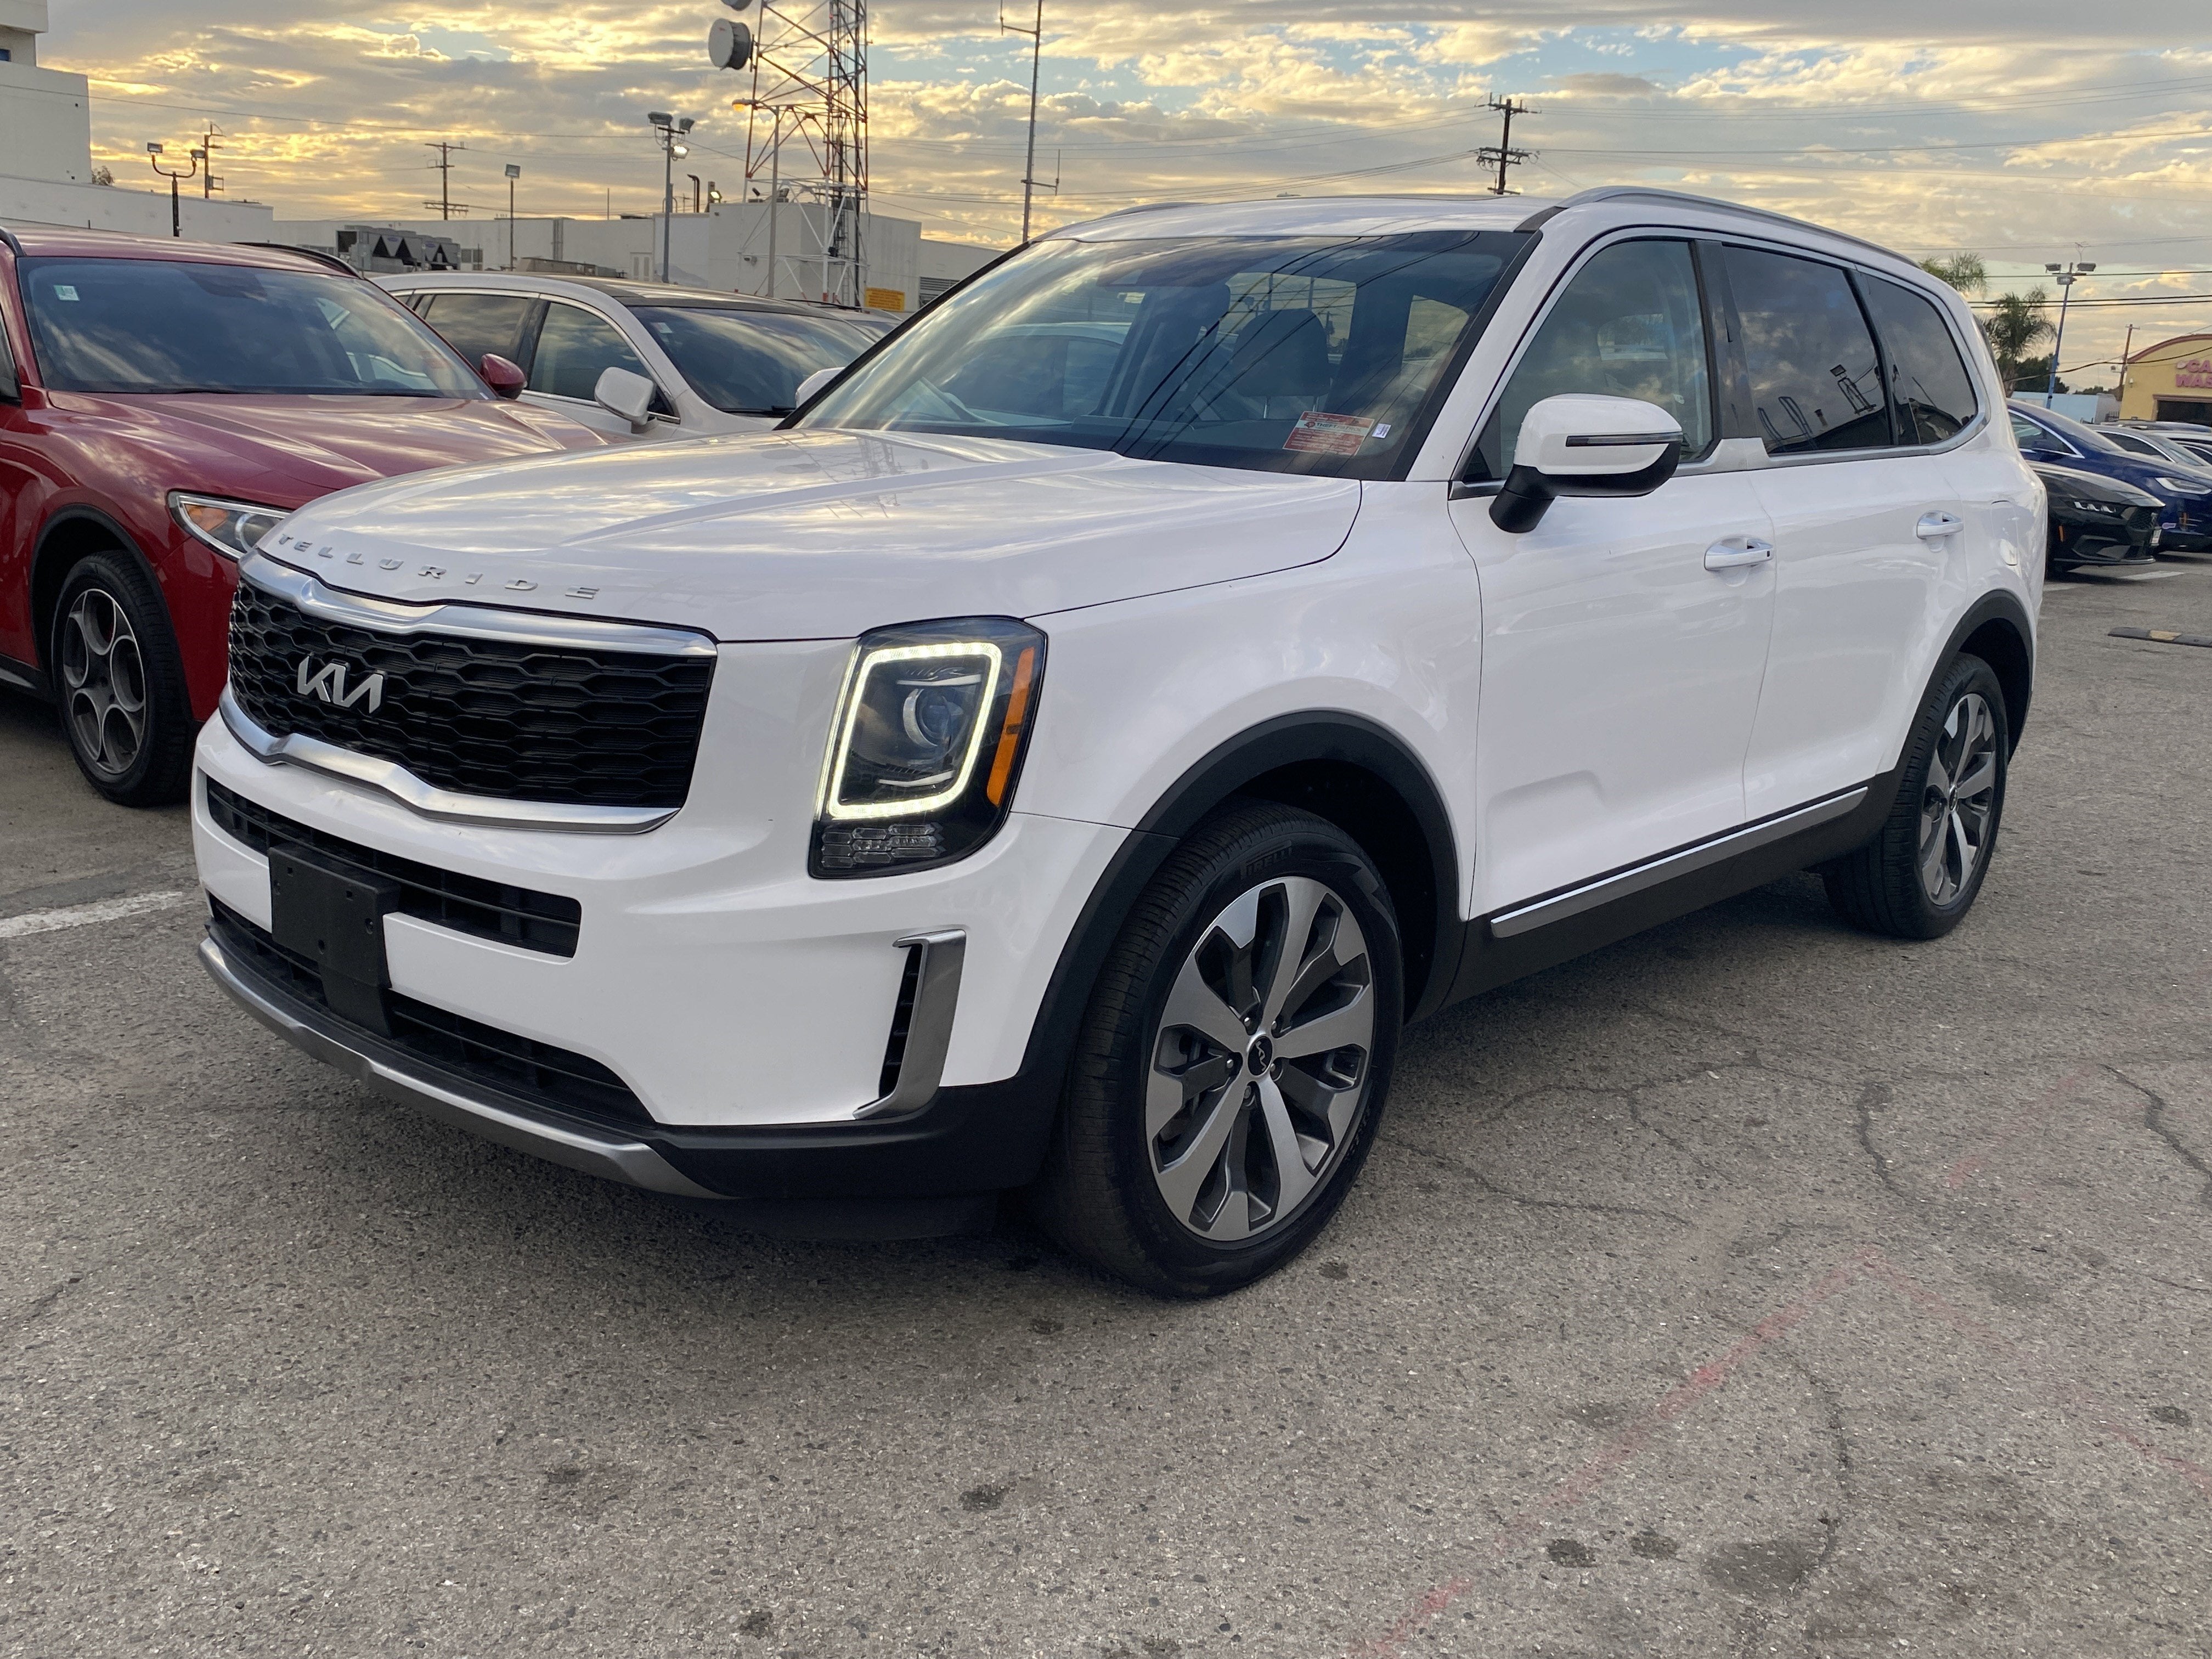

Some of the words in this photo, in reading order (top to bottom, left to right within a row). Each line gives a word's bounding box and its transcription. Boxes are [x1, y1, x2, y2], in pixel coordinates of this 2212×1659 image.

[1317, 422, 1361, 433] THEFTTROL
[279, 534, 600, 600] TELLURIDE
[297, 654, 384, 714] KIA
[1240, 839, 1292, 880] PIRELLI
